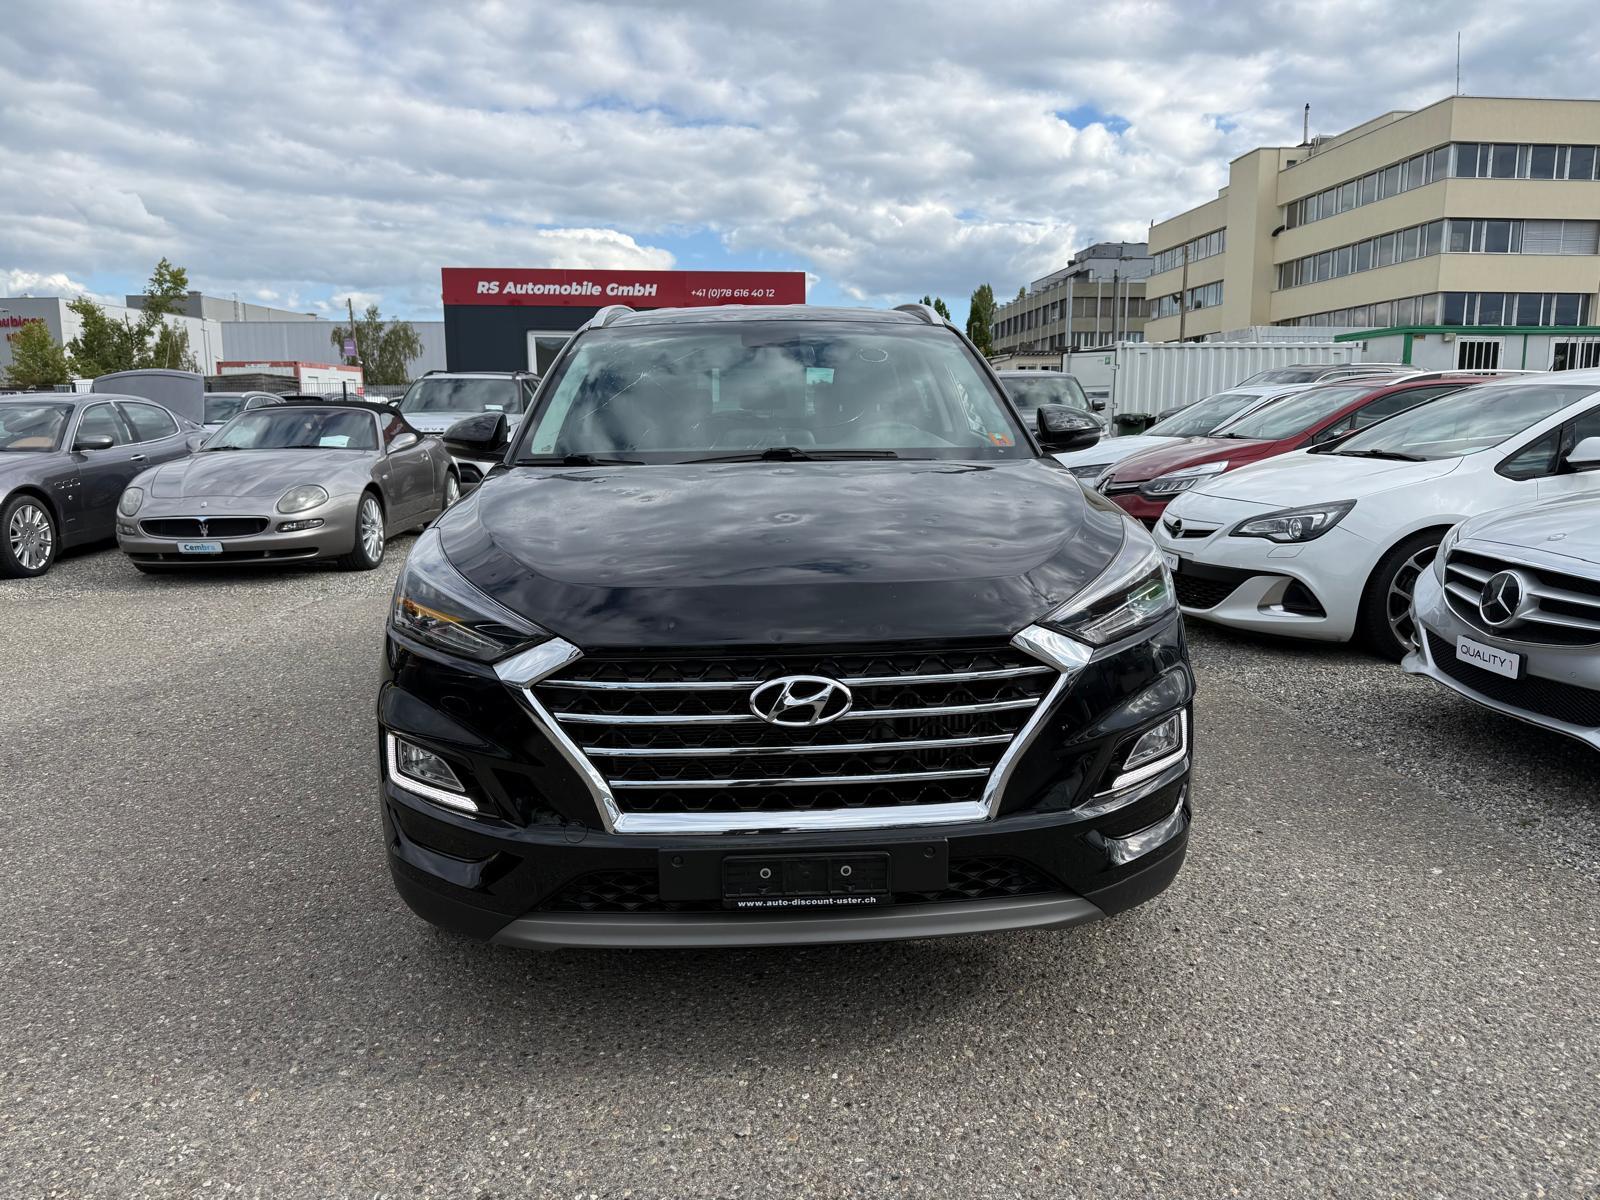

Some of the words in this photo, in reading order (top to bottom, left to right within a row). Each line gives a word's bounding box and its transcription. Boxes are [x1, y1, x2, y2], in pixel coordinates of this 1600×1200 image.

[477, 281, 499, 294] RS
[503, 281, 601, 295] Automobile
[606, 283, 657, 296] GmbH
[691, 289, 706, 297] +41
[708, 288, 732, 299] (0)78
[733, 289, 749, 297] 616
[751, 289, 764, 297] 40
[766, 289, 775, 297] 12
[183, 543, 216, 551] Cembra
[1461, 645, 1506, 667] QUALITY
[1508, 659, 1513, 671] 1
[738, 897, 876, 906] www.auto-discount-uster.ch
